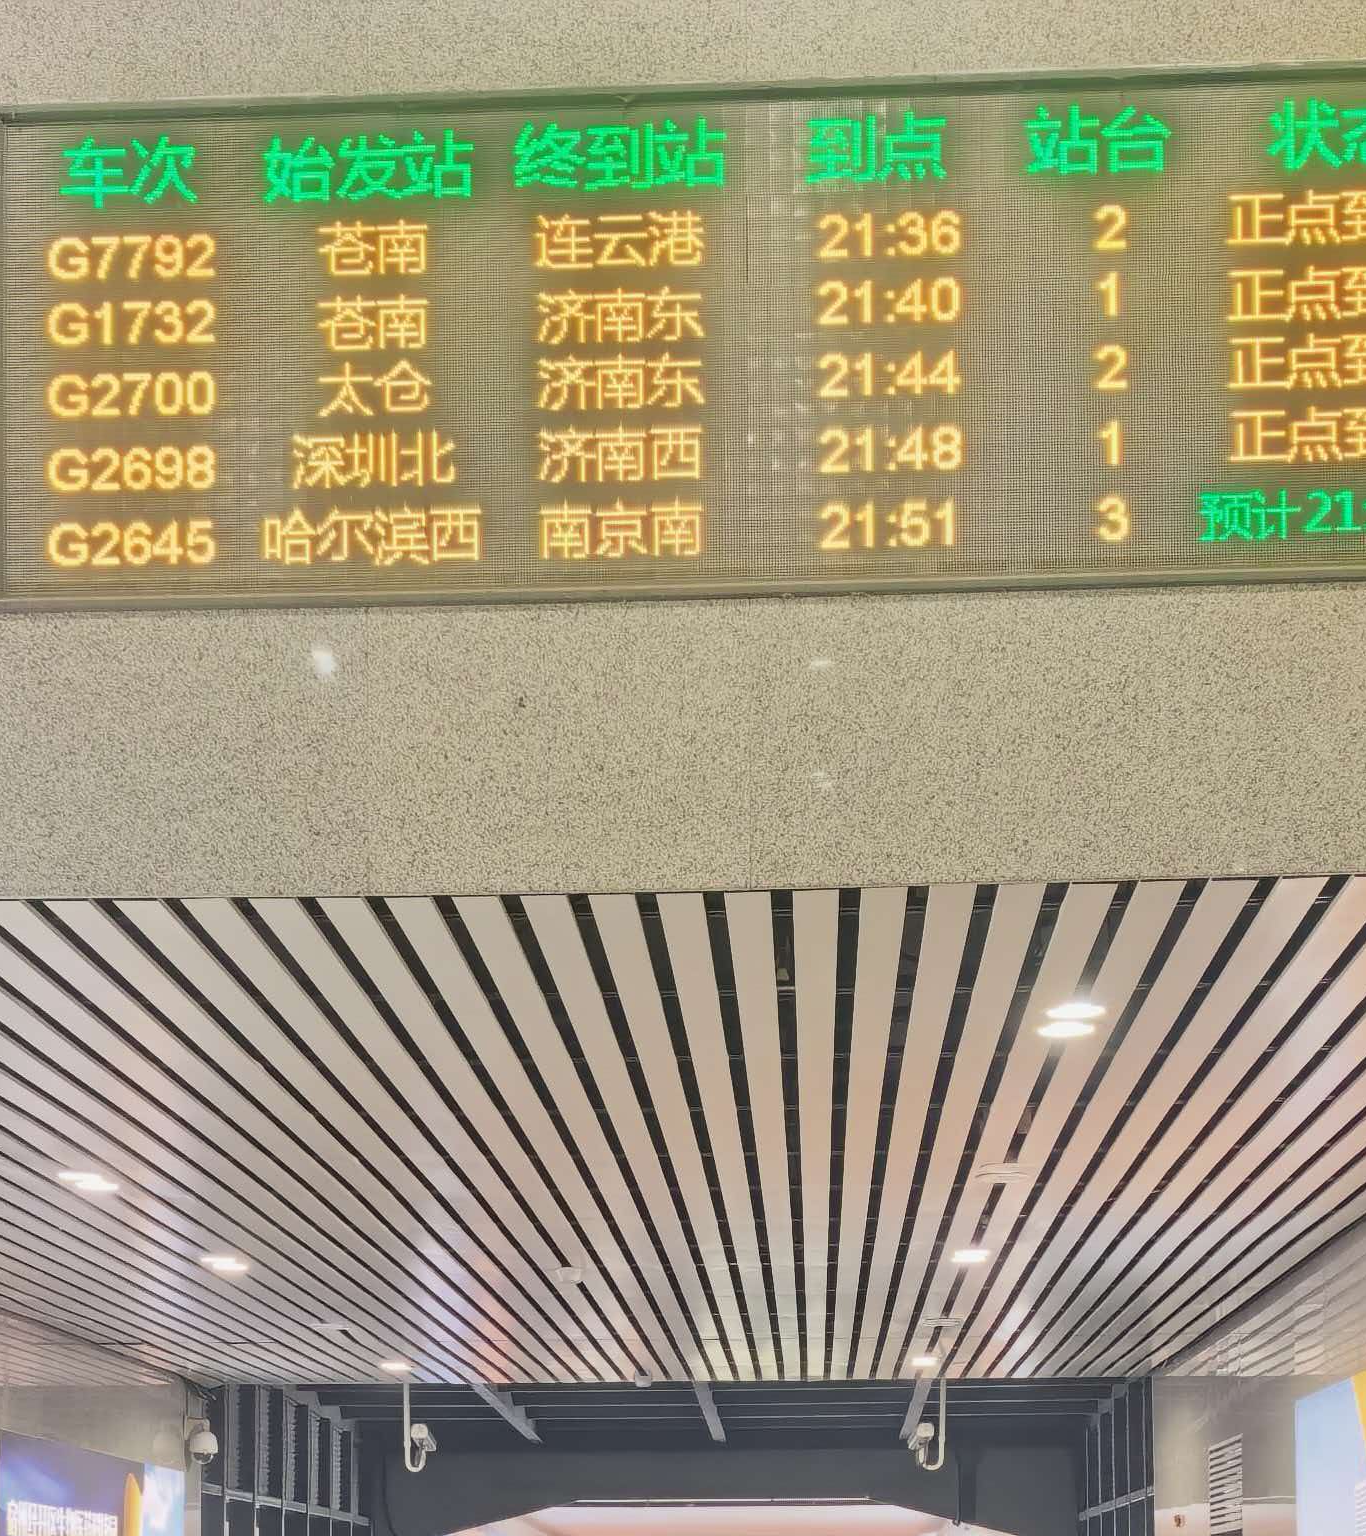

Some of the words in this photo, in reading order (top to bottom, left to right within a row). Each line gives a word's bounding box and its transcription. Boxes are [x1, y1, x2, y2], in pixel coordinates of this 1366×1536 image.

[58, 132, 198, 209] 车次
[262, 128, 475, 205] 始发站
[512, 115, 728, 192] 终到站
[804, 110, 948, 185] 到点
[1023, 102, 1172, 177] 站台
[47, 234, 215, 280] G7792
[318, 219, 428, 276] 苍南
[535, 210, 704, 269] 连云港
[819, 210, 960, 258] 21:36
[1095, 205, 1127, 249] 2
[47, 300, 216, 345] G1732
[318, 294, 429, 350] 苍南
[538, 286, 705, 344] 济南东
[819, 277, 960, 324] 21:40
[1098, 272, 1119, 316] 1
[47, 372, 215, 417] G2700
[319, 360, 432, 417] 太仓
[539, 353, 705, 411] 济南东
[819, 350, 961, 398] 21:44
[1096, 345, 1127, 389] 2
[48, 446, 216, 491] G2698
[293, 430, 455, 489] 深圳北
[539, 426, 703, 483] 济南西
[820, 425, 962, 473] 21:48
[1100, 420, 1121, 465] 1
[48, 520, 216, 566] G2645
[264, 507, 482, 565] 哈尔滨西
[540, 500, 703, 559] 南京南
[821, 501, 956, 549] 21:51
[1099, 496, 1129, 541] 3
